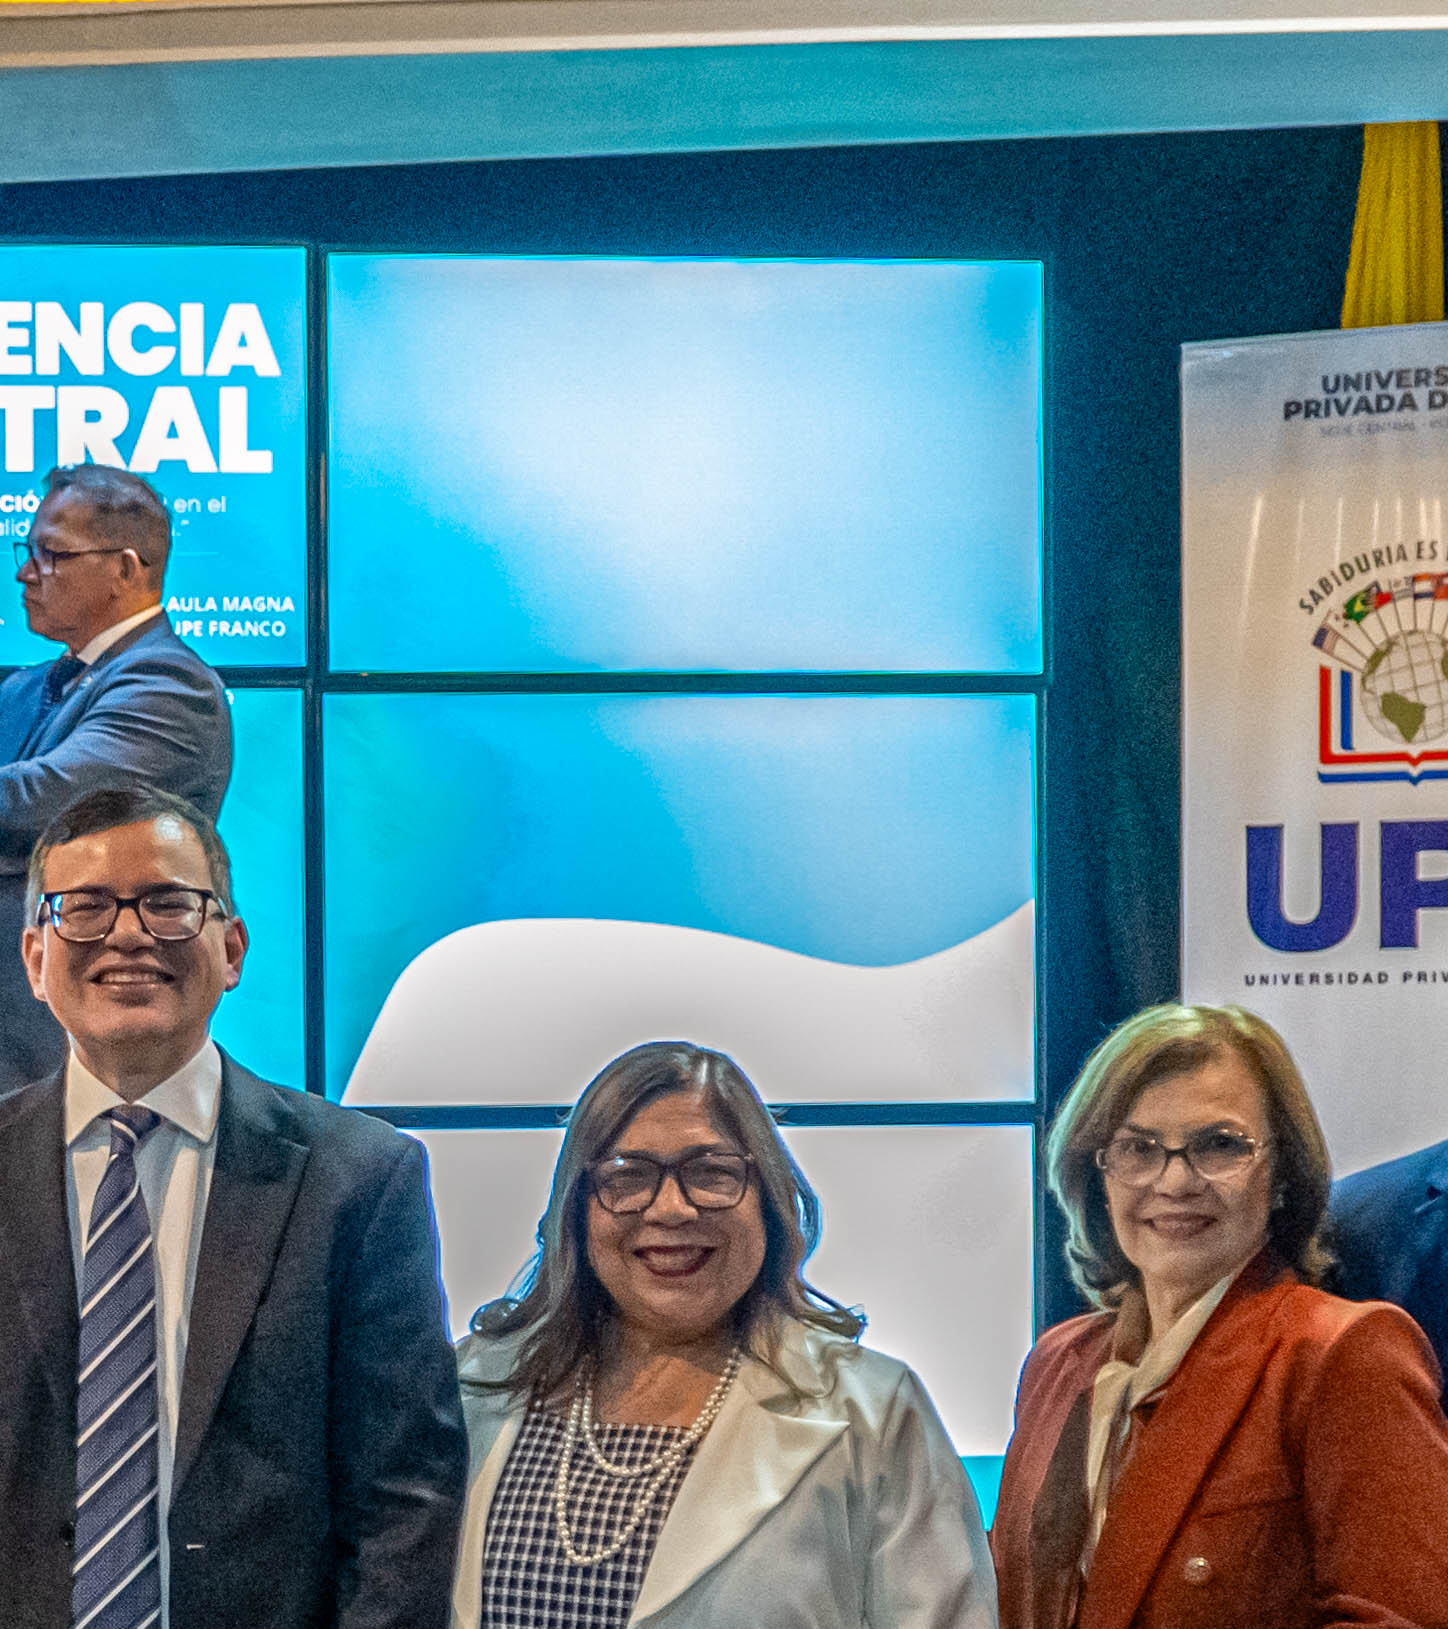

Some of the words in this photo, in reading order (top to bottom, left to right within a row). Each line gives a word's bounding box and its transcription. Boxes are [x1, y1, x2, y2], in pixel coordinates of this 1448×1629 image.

[1283, 391, 1418, 421] PRIVADA
[174, 499, 202, 512] en
[207, 496, 227, 512] el
[1299, 543, 1408, 614] SABIDURIA
[1416, 541, 1438, 560] ES
[166, 596, 218, 612] AULA
[222, 596, 295, 612] MAGNA
[208, 620, 286, 637] FRANCO
[1244, 971, 1389, 986] UNIVERSIDAD
